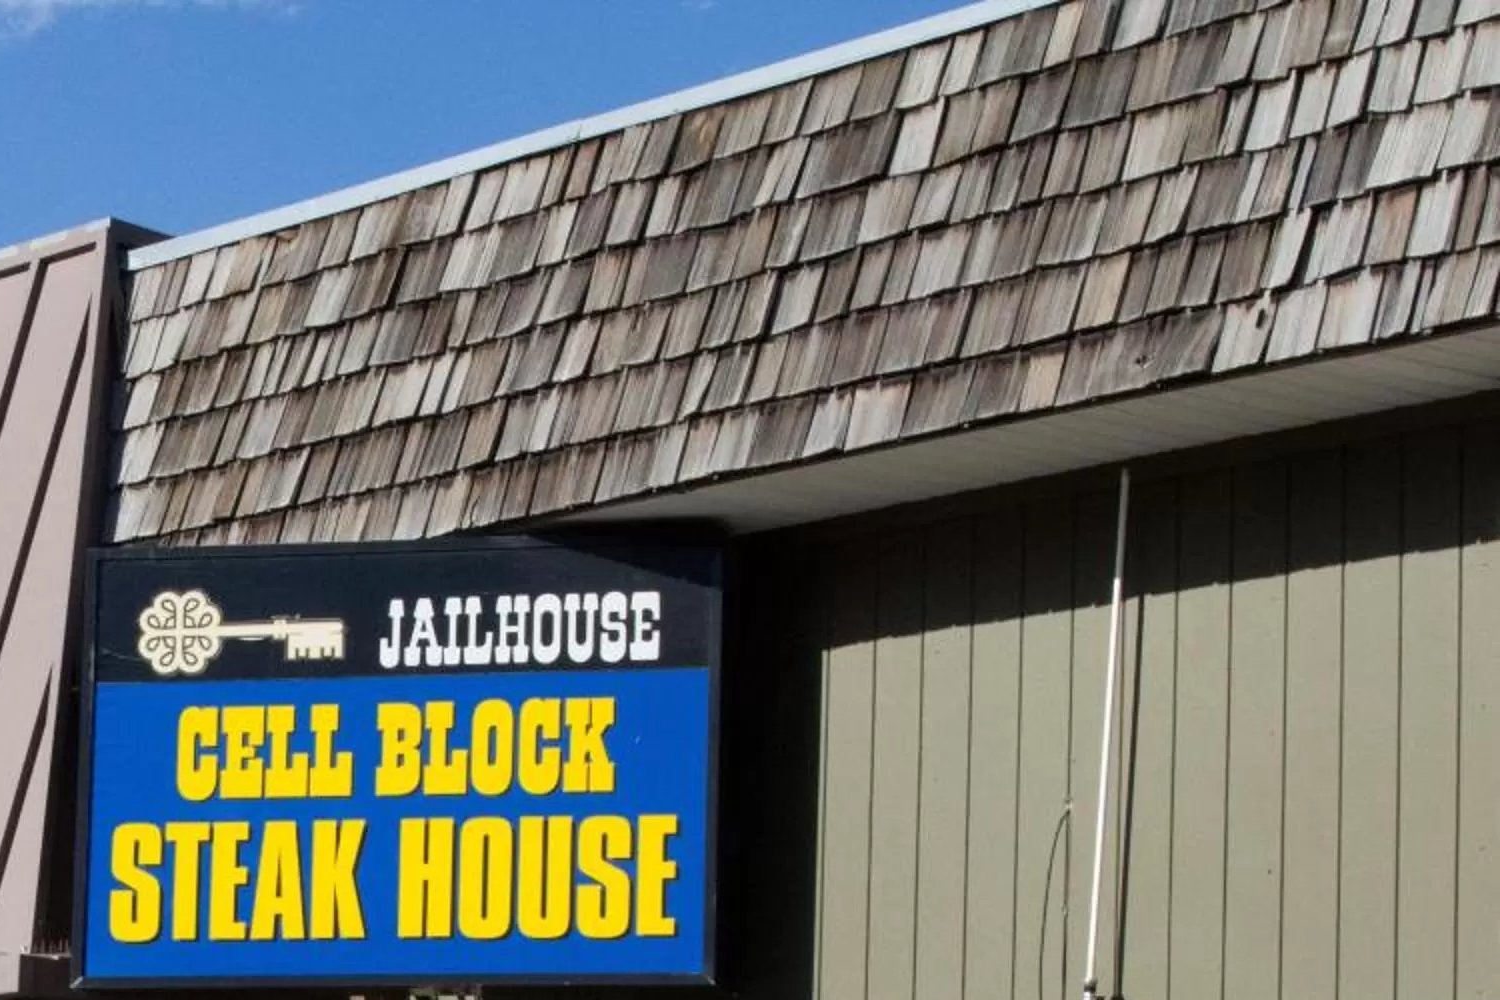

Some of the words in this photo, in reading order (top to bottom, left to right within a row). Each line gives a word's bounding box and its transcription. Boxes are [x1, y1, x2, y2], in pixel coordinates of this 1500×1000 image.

[379, 591, 661, 668] JAILHOUSE
[175, 703, 353, 801] CELL
[375, 696, 616, 796] BLOCK
[108, 818, 368, 943] STEAK
[396, 813, 679, 940] HOUSE
